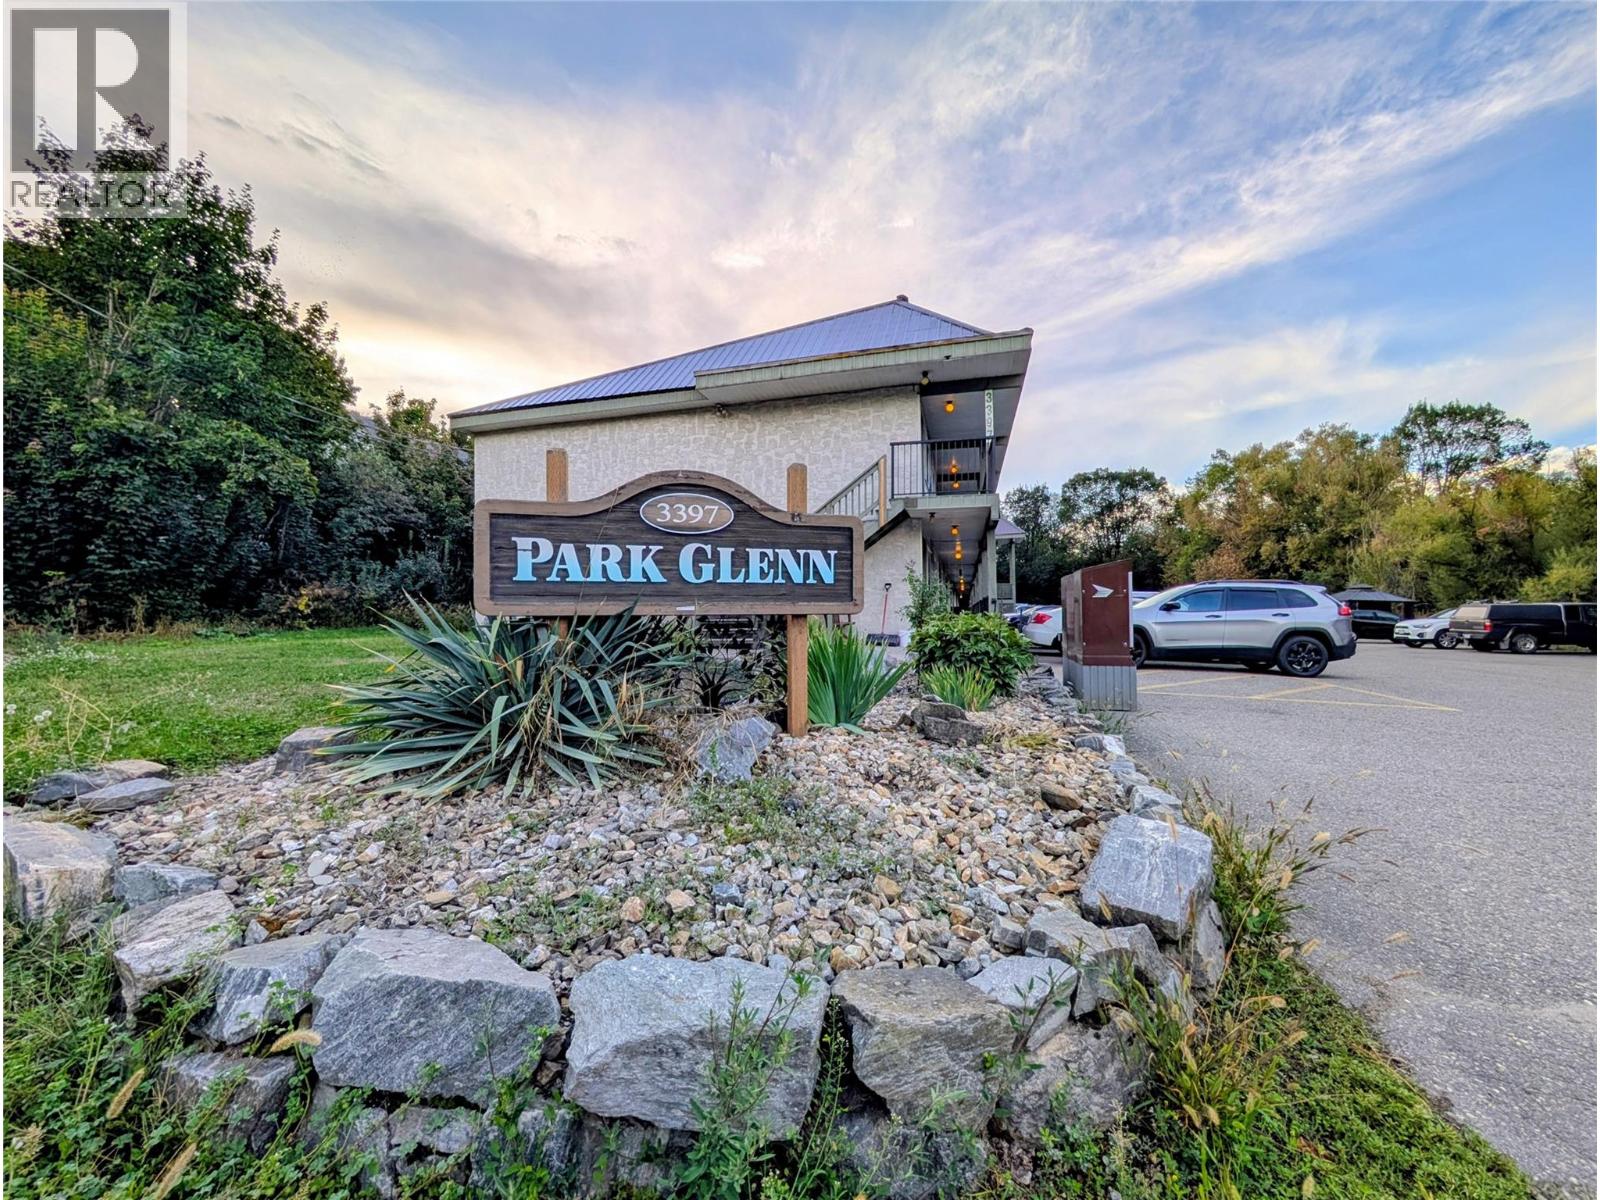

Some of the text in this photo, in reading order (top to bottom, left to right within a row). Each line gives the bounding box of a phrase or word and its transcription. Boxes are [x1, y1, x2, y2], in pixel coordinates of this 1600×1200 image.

[655, 502, 719, 525] 3397
[511, 536, 838, 585] PARK GLENN
